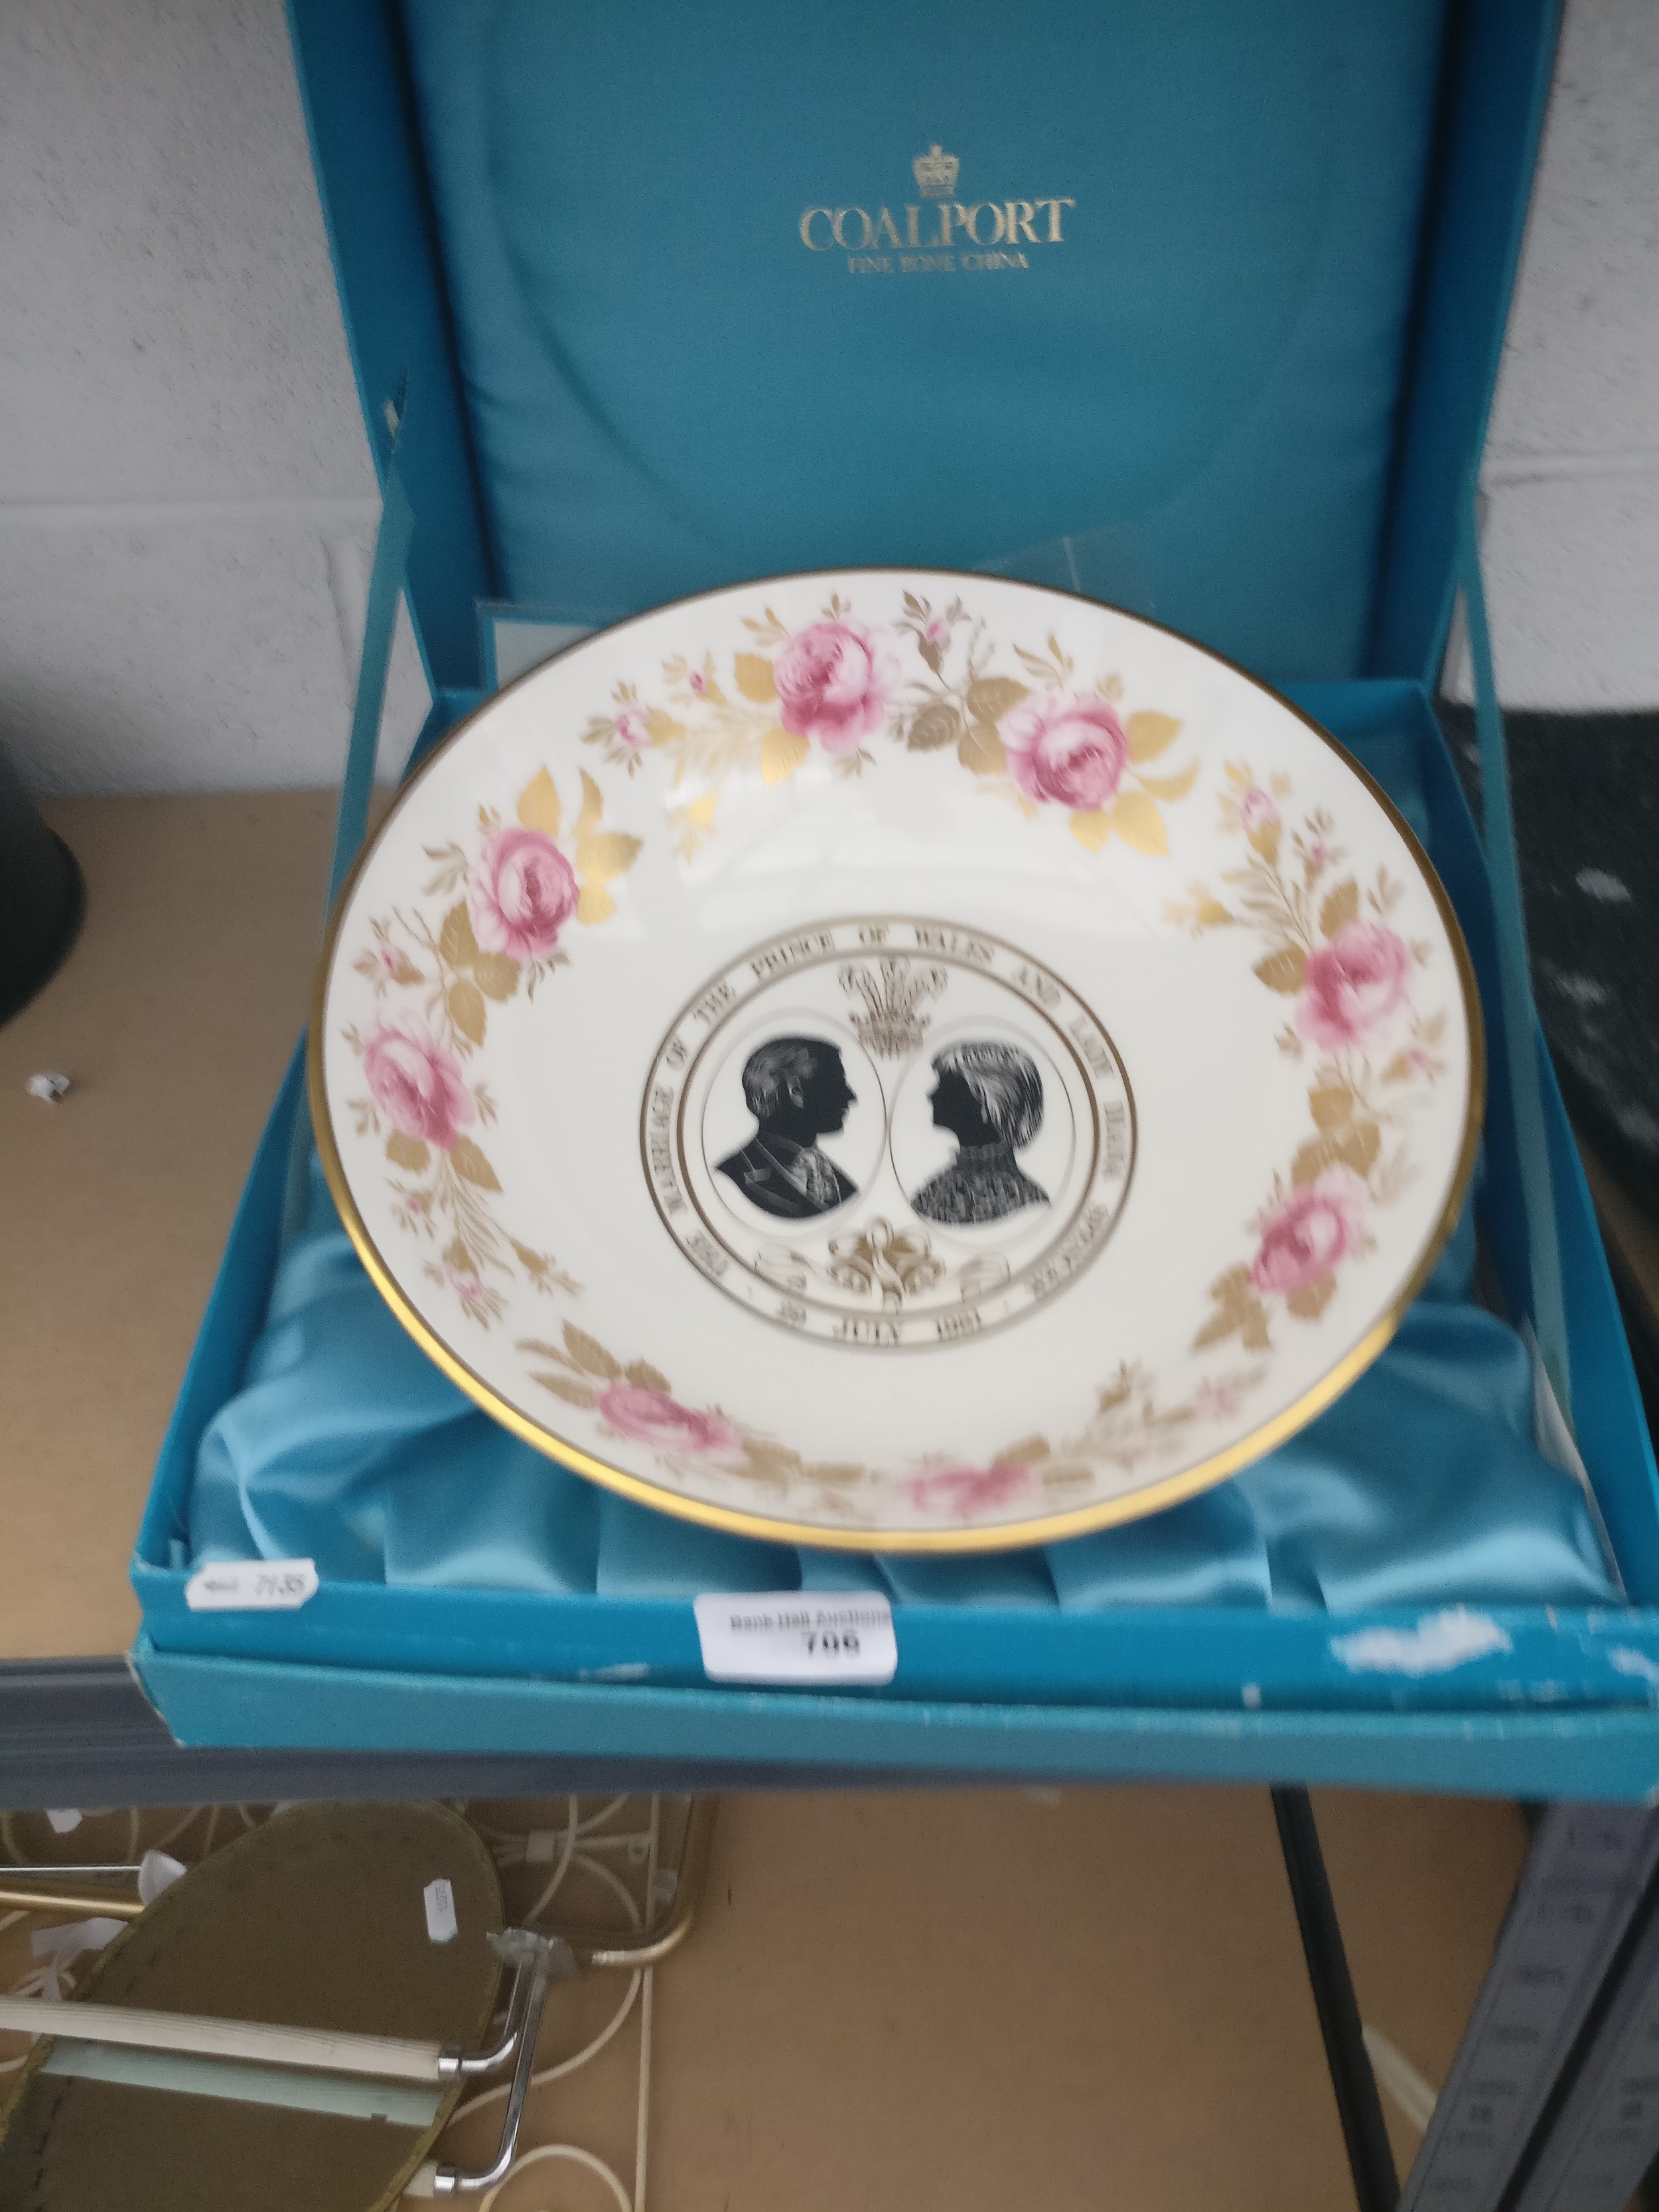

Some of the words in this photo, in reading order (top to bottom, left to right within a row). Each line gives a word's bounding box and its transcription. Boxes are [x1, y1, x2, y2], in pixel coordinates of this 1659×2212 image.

[800, 198, 1076, 251] COALPORT
[961, 251, 1029, 271] CHINA
[750, 928, 836, 980] PRINCE
[800, 1629, 860, 1659] 706
